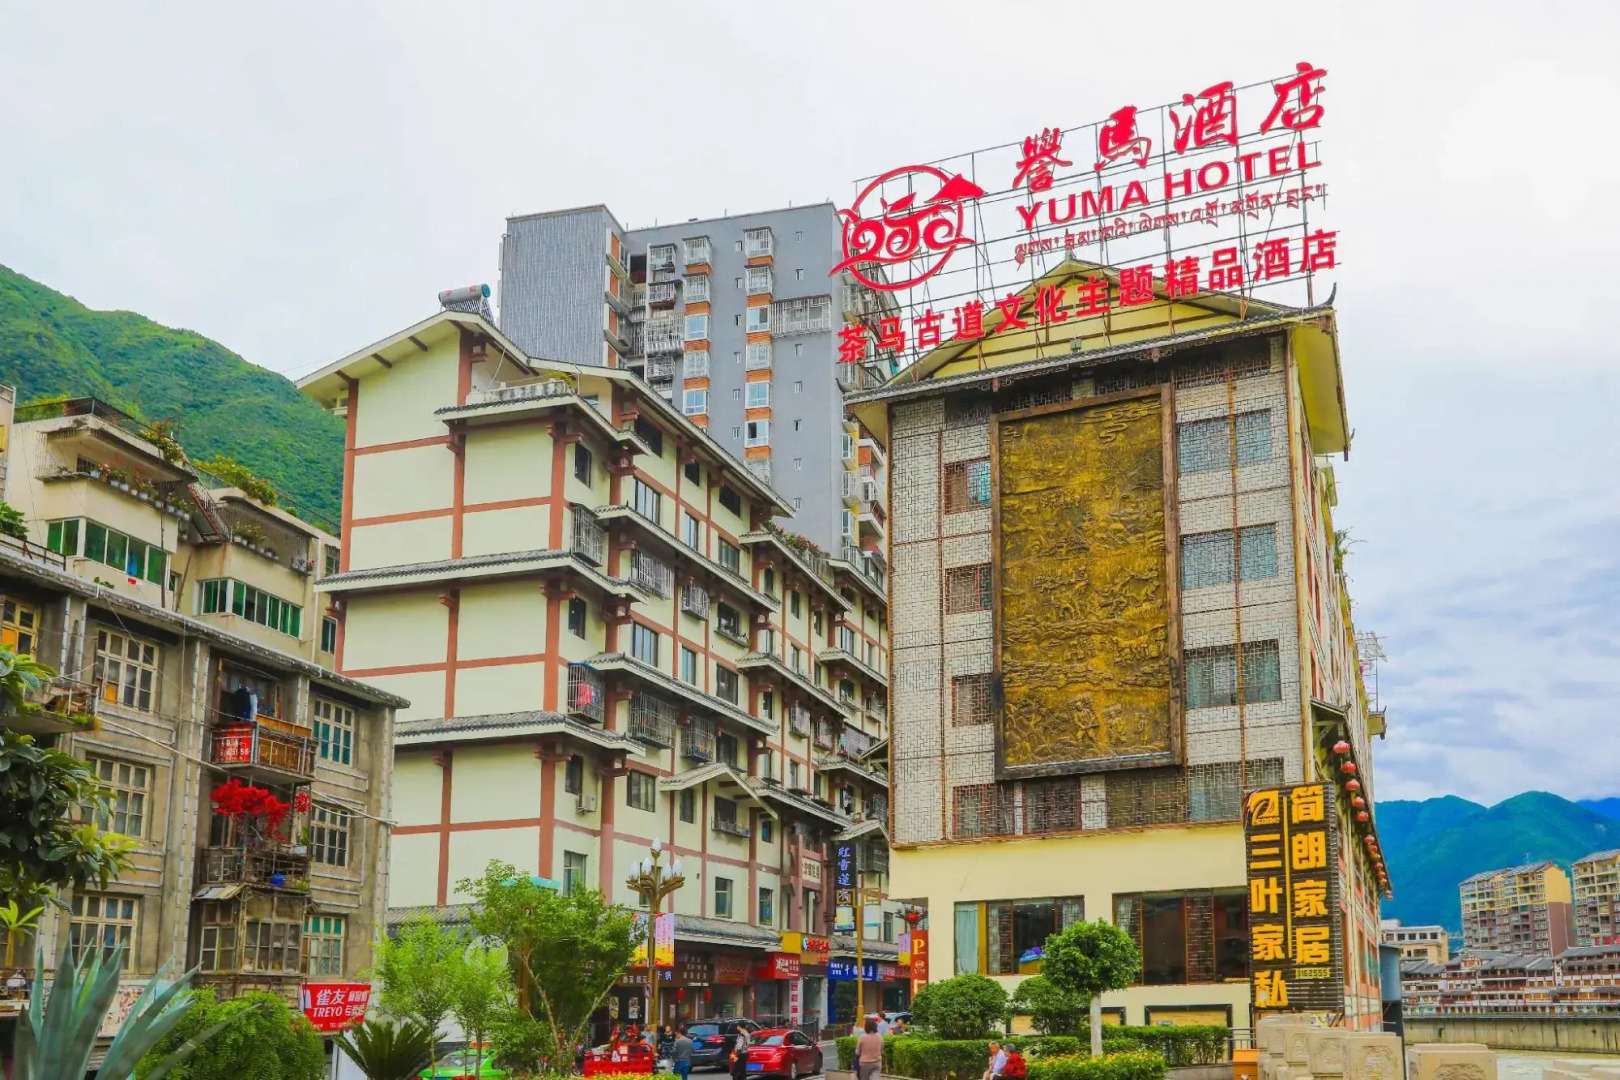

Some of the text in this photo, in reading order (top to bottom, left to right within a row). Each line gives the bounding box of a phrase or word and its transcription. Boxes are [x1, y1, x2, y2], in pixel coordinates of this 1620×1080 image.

[1016, 140, 1322, 231] YUMA HOTEL
[836, 229, 1337, 365] 茶马古道文化主题精品酒店
[1250, 833, 1289, 1008] 三叶家私
[1290, 784, 1331, 965] 简朗家居
[912, 938, 925, 955] P
[313, 1006, 343, 1018] TREYO
